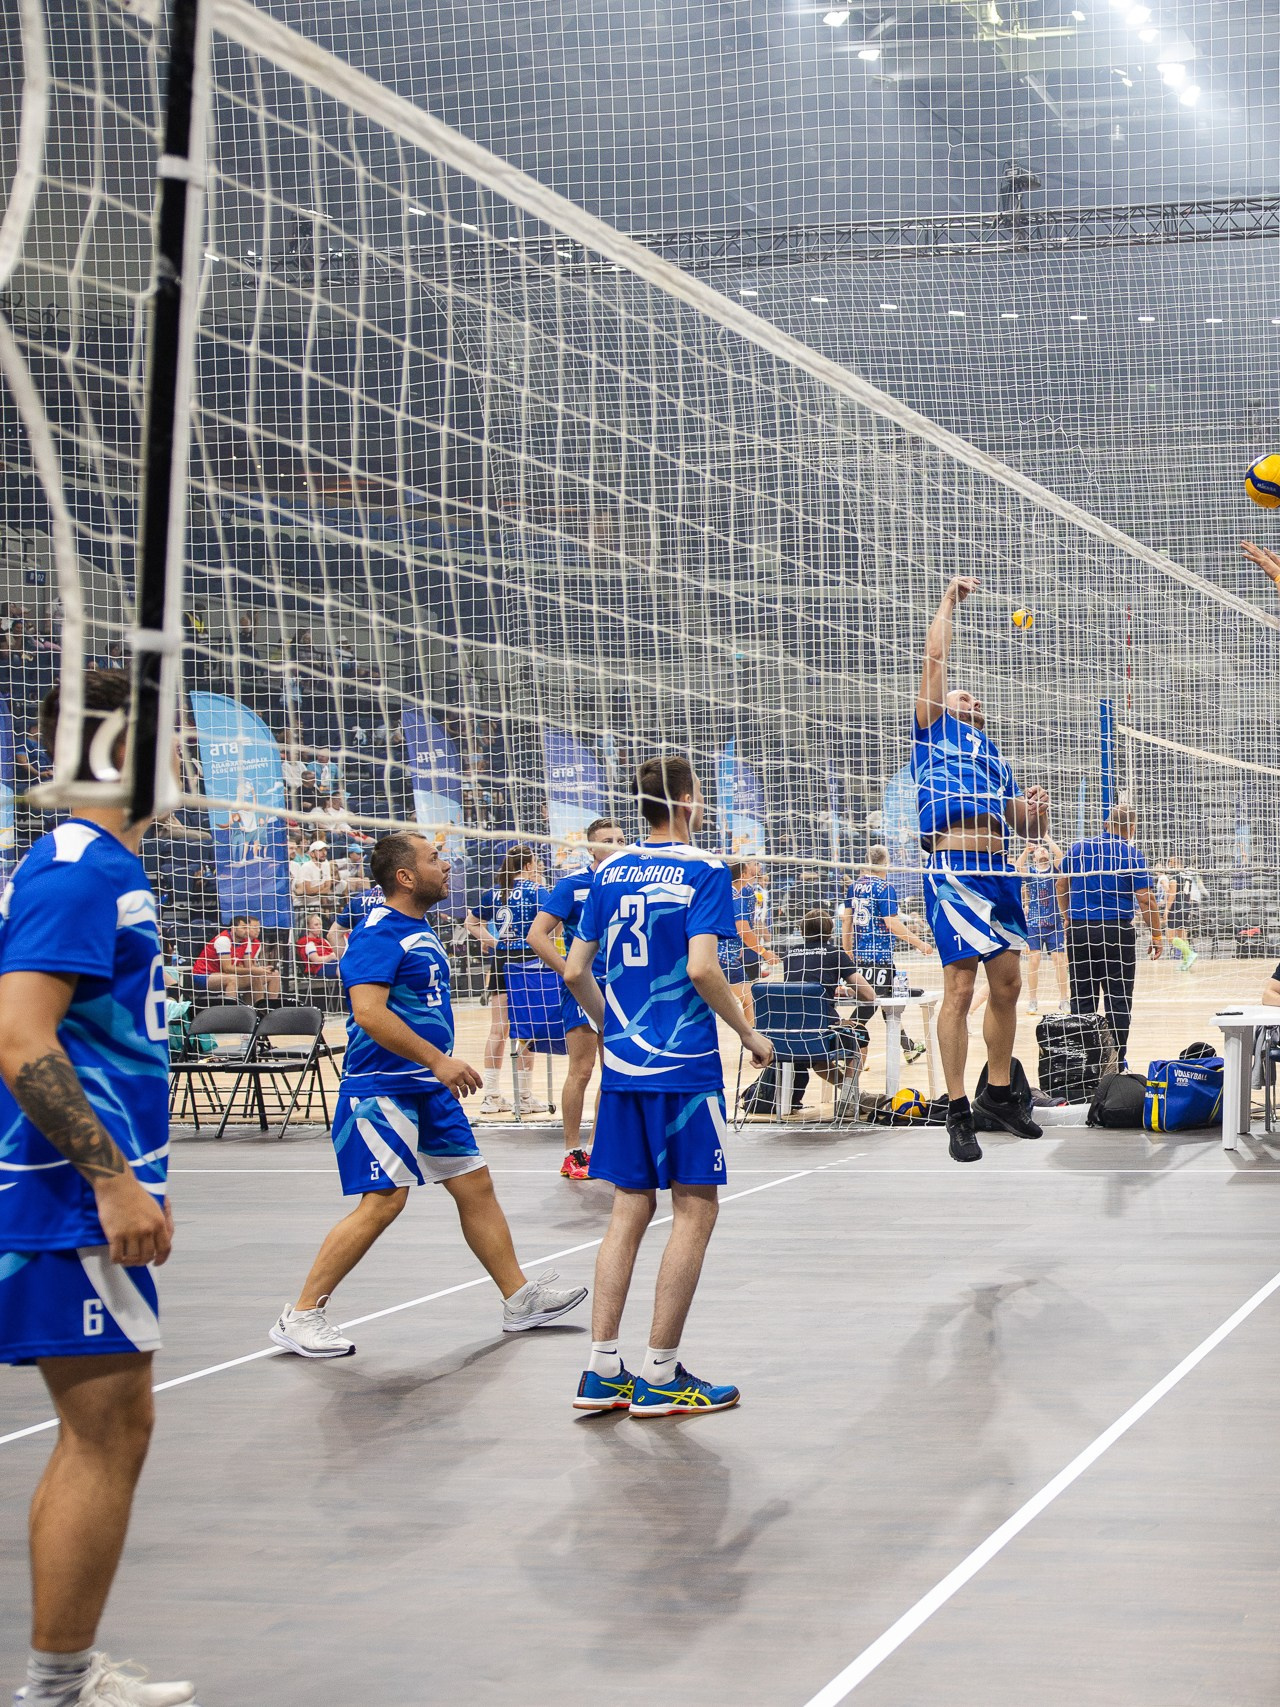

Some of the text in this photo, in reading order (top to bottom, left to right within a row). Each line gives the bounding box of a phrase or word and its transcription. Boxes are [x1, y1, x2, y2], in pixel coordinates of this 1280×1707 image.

[965, 733, 982, 759] 7
[601, 865, 685, 886] ЕМЕЛЬЯНОВ
[496, 907, 515, 939] 2
[620, 894, 649, 967] 3
[953, 934, 963, 951] 7
[427, 963, 443, 1007] 5
[876, 969, 888, 985] 6
[1174, 1069, 1208, 1081] VOLLEYBALL
[370, 1160, 380, 1181] 5
[713, 1149, 723, 1172] 3
[83, 1299, 104, 1337] 6
